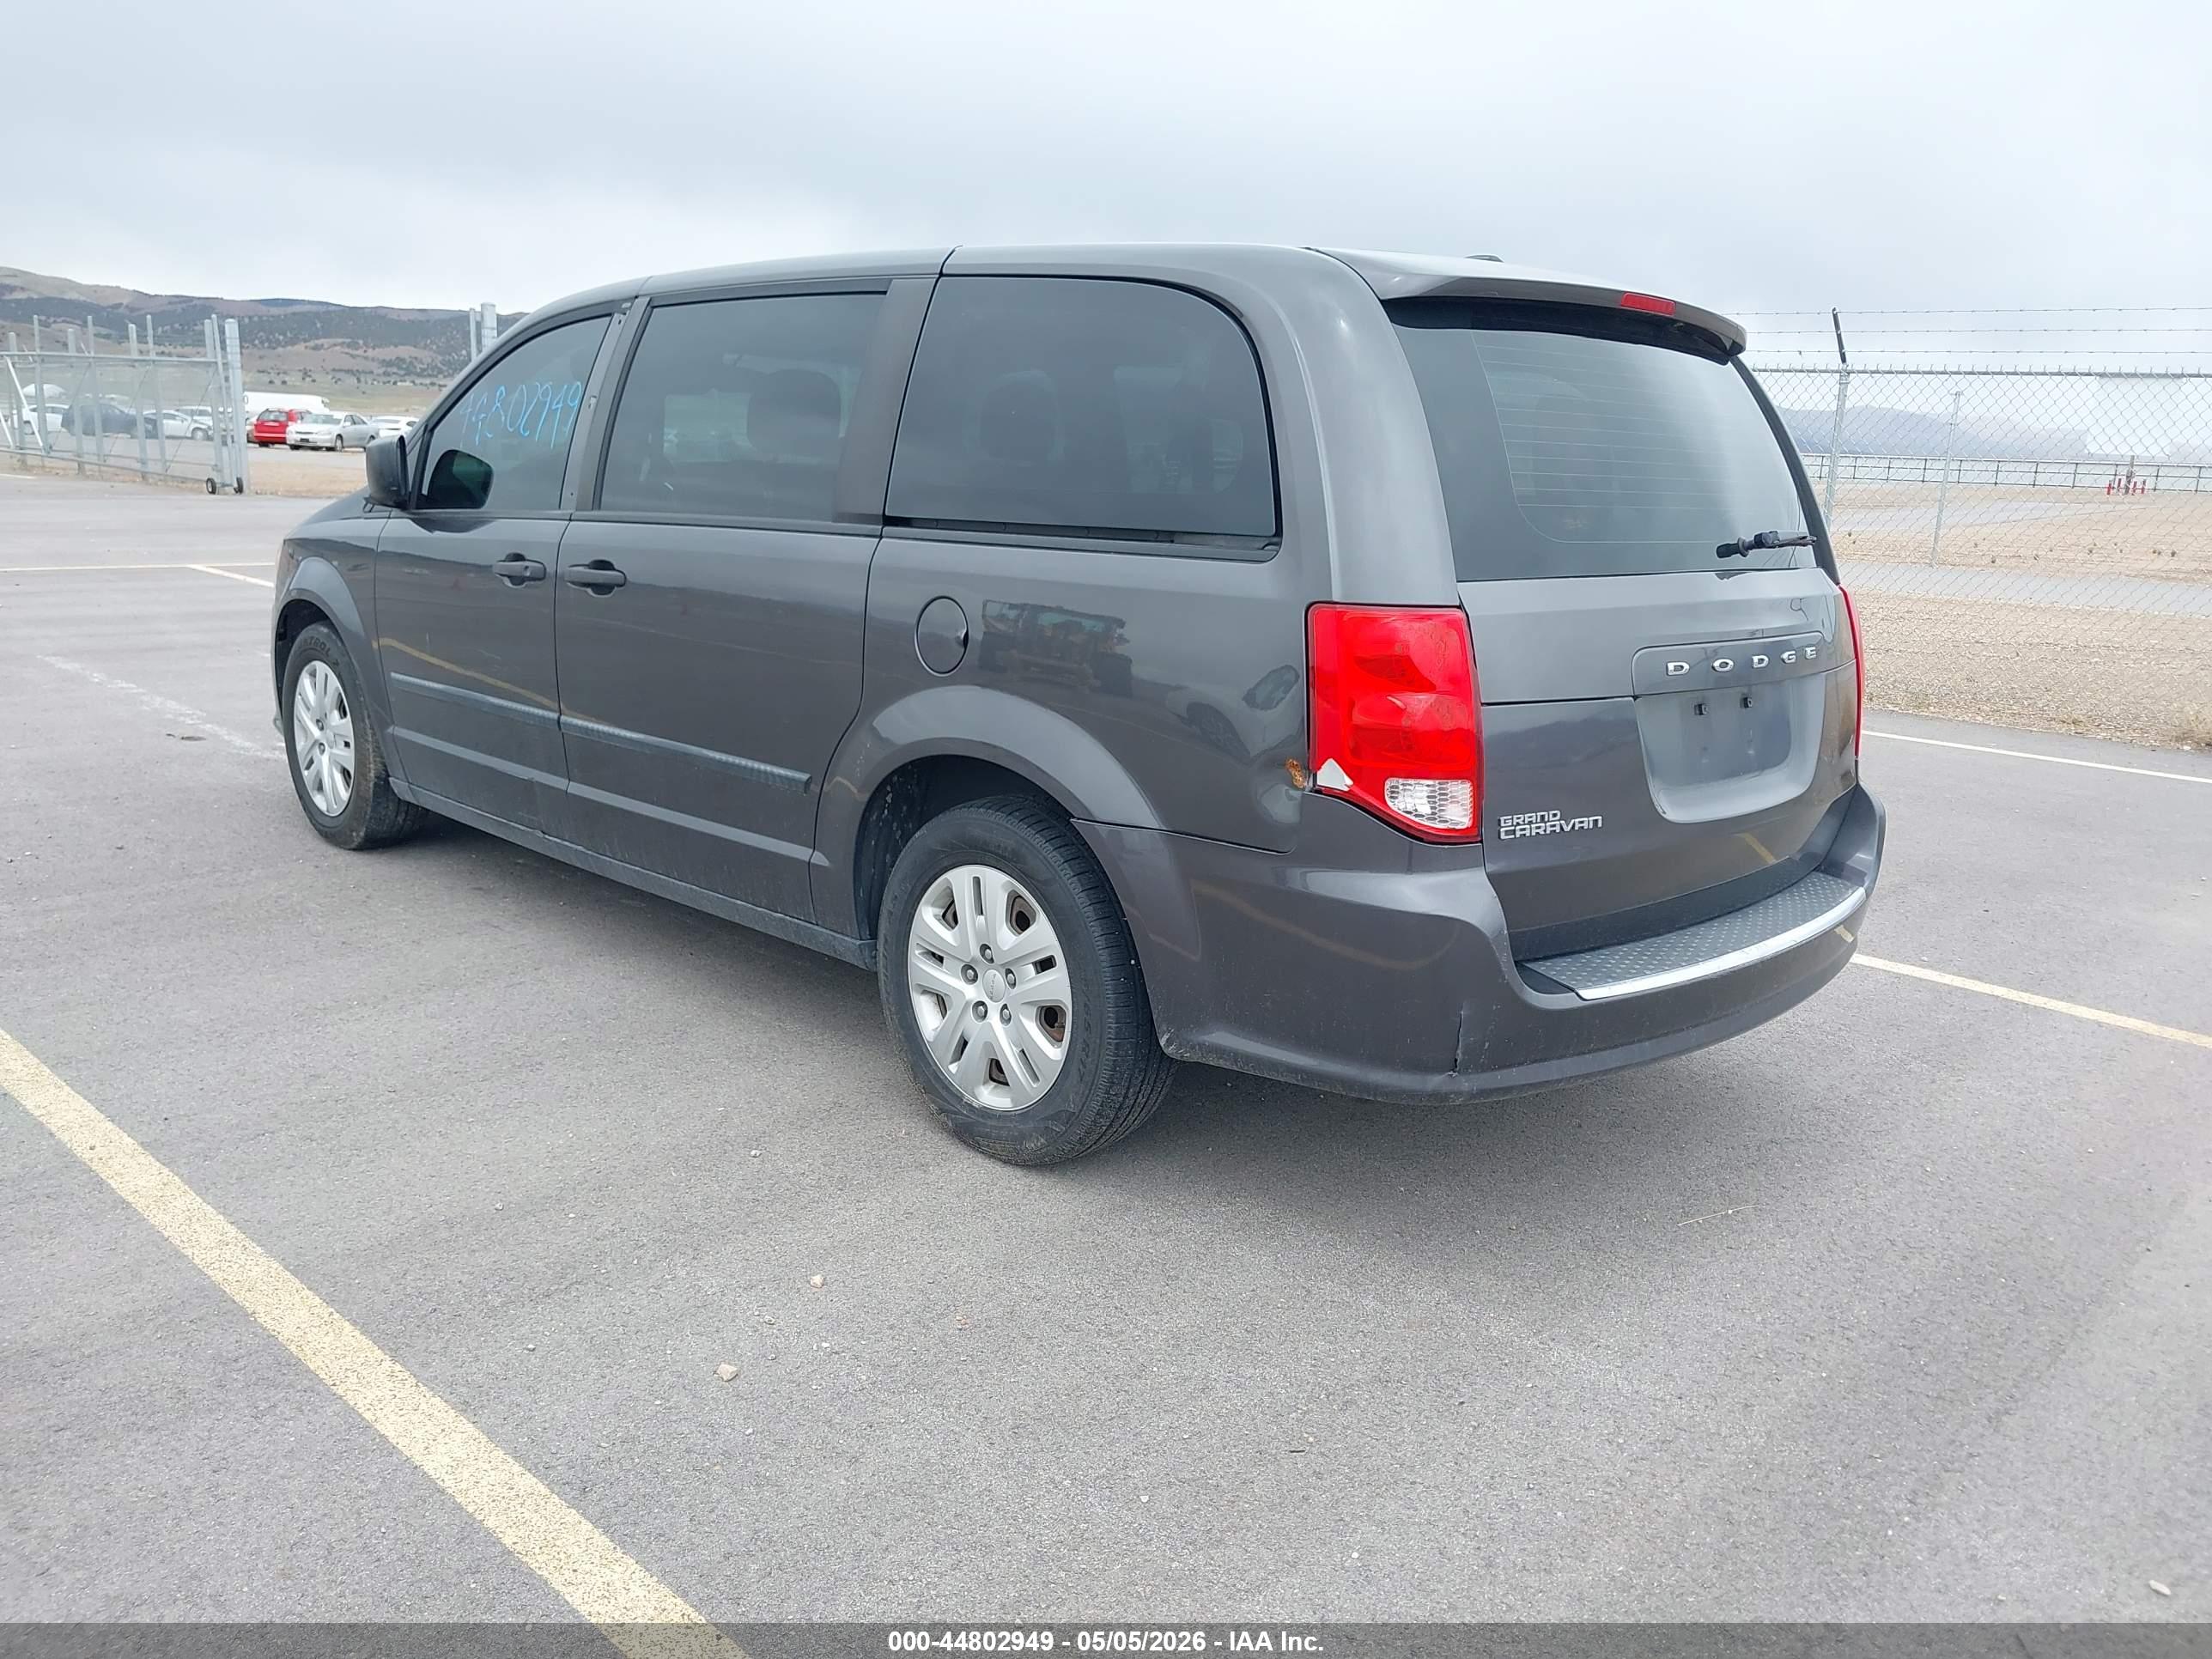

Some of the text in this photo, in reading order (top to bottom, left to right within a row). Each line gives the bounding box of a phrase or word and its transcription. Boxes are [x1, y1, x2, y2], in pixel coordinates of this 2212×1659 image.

[1666, 647, 1818, 677] DODGE
[1499, 810, 1561, 827] GRAND
[1499, 816, 1603, 840] CARAVAN
